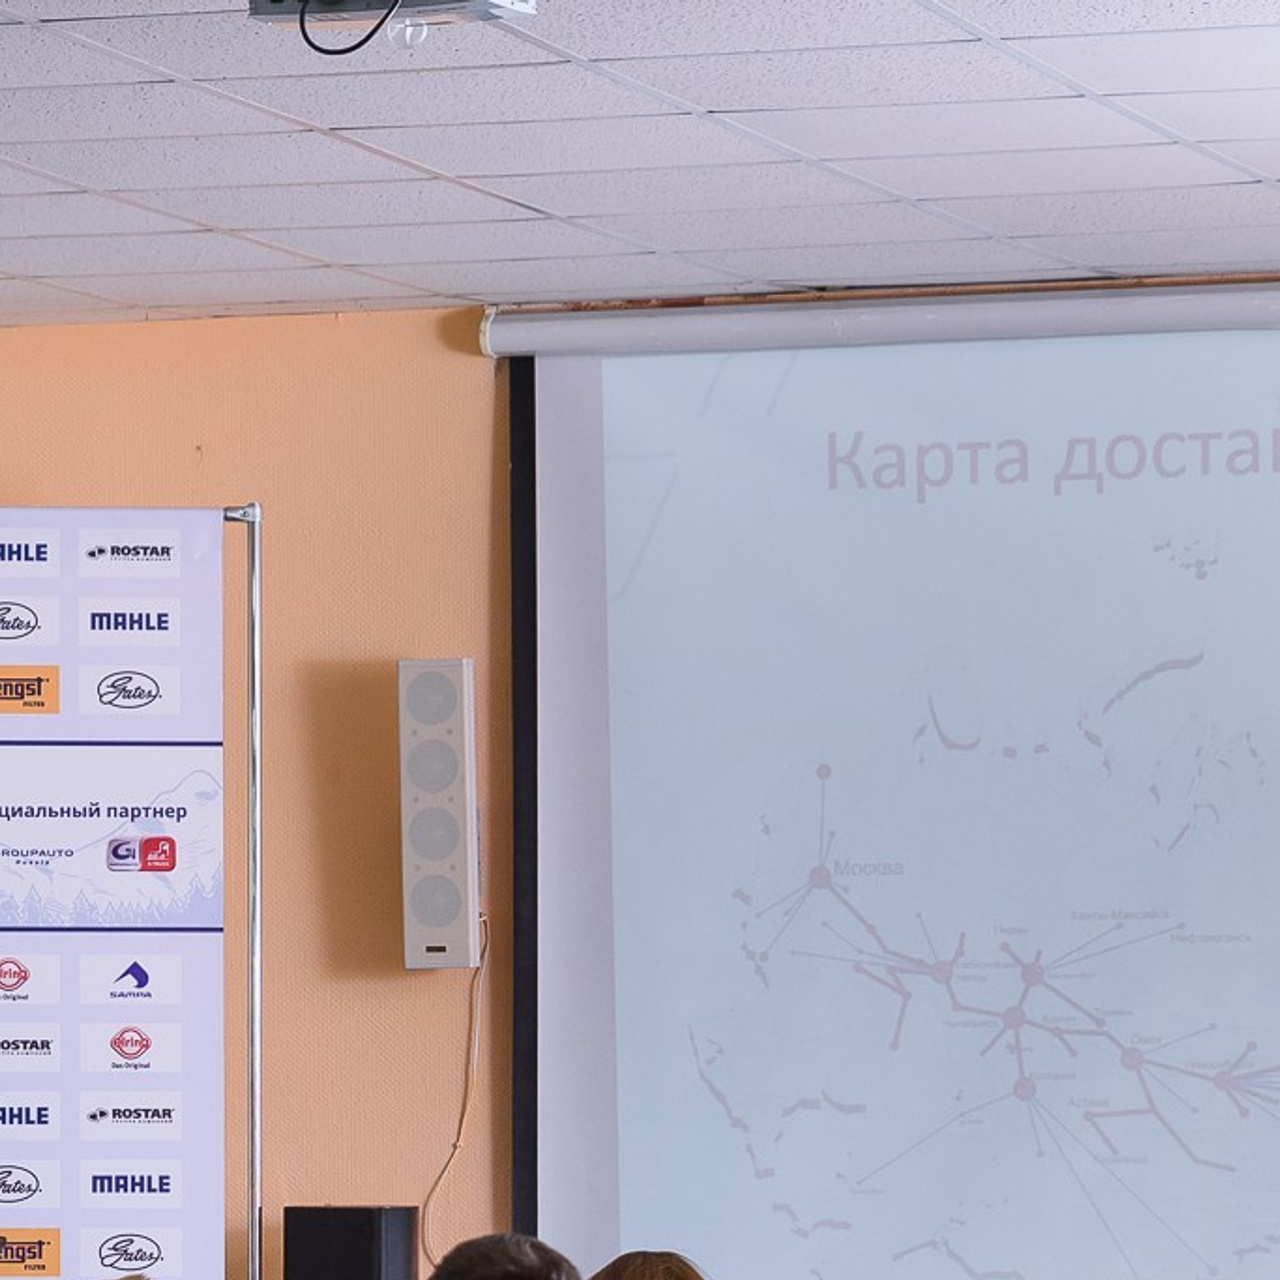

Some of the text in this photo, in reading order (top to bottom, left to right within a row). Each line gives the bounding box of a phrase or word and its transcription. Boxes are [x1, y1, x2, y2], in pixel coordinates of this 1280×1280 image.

[827, 430, 1030, 503] Карта
[110, 546, 171, 557] ROSTAR
[91, 613, 169, 630] MAHLE
[102, 675, 155, 706] Gates
[107, 806, 187, 822] партнер
[833, 859, 904, 877] Москва
[112, 1109, 173, 1119] ROSTAR
[91, 1175, 170, 1193] MAHLE
[104, 1238, 157, 1268] Gates
